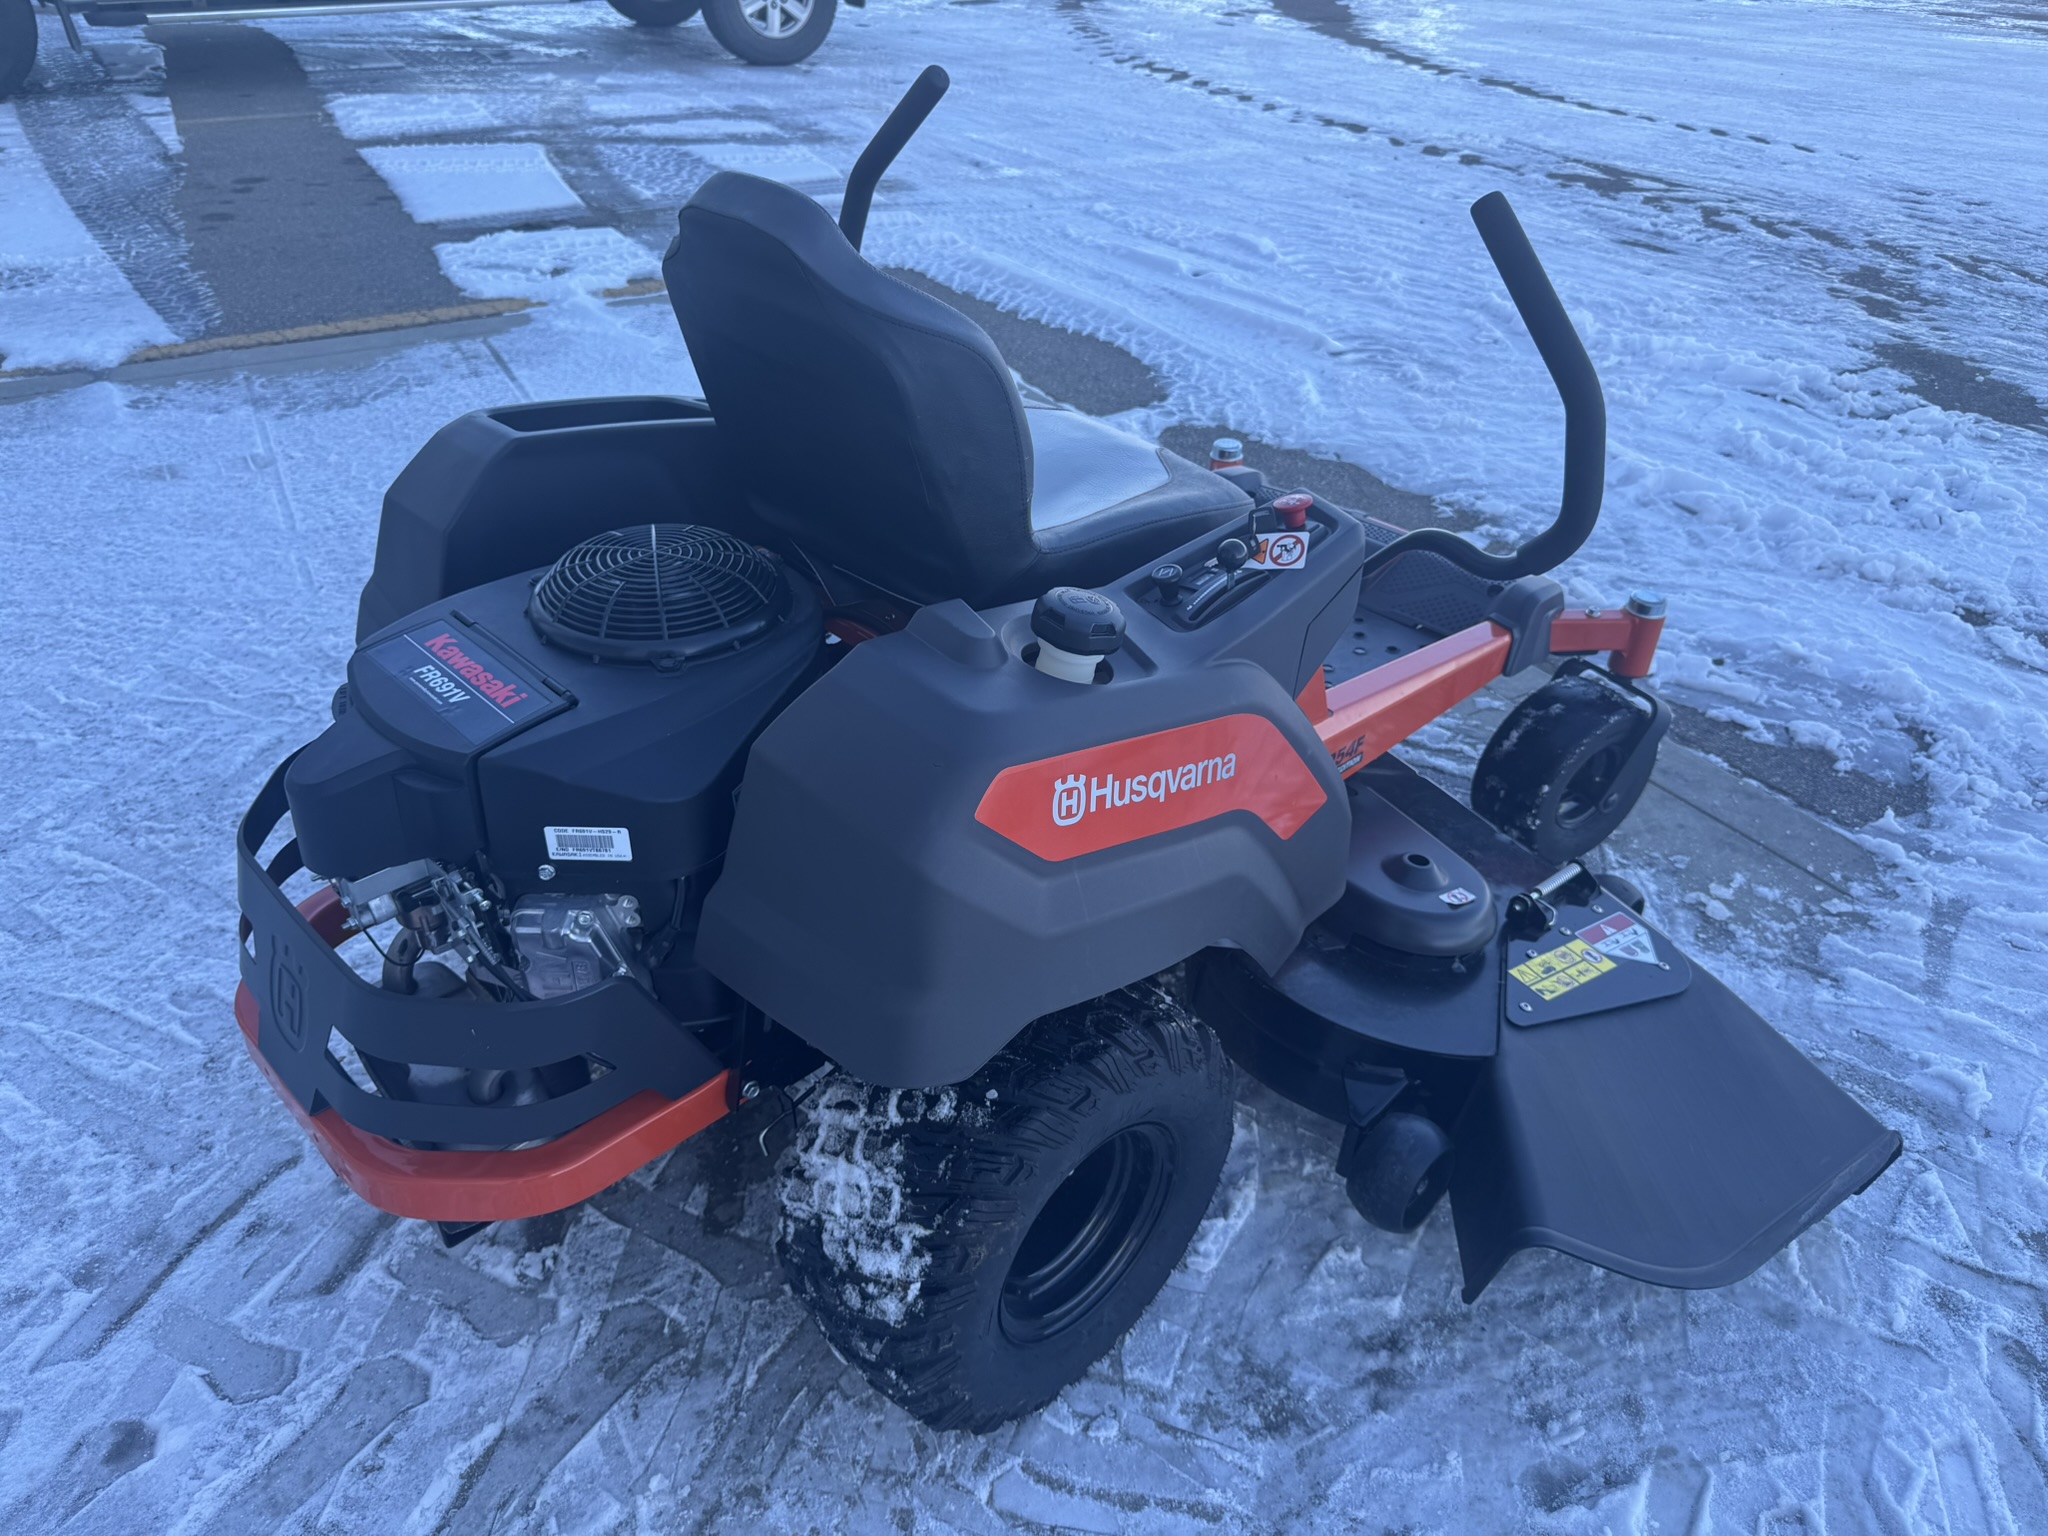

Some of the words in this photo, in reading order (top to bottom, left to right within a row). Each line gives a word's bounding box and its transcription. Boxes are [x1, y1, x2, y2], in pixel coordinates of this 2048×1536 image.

[413, 664, 471, 703] FR691V
[424, 633, 529, 708] Kawasaki
[1089, 752, 1237, 813] Husqvarna
